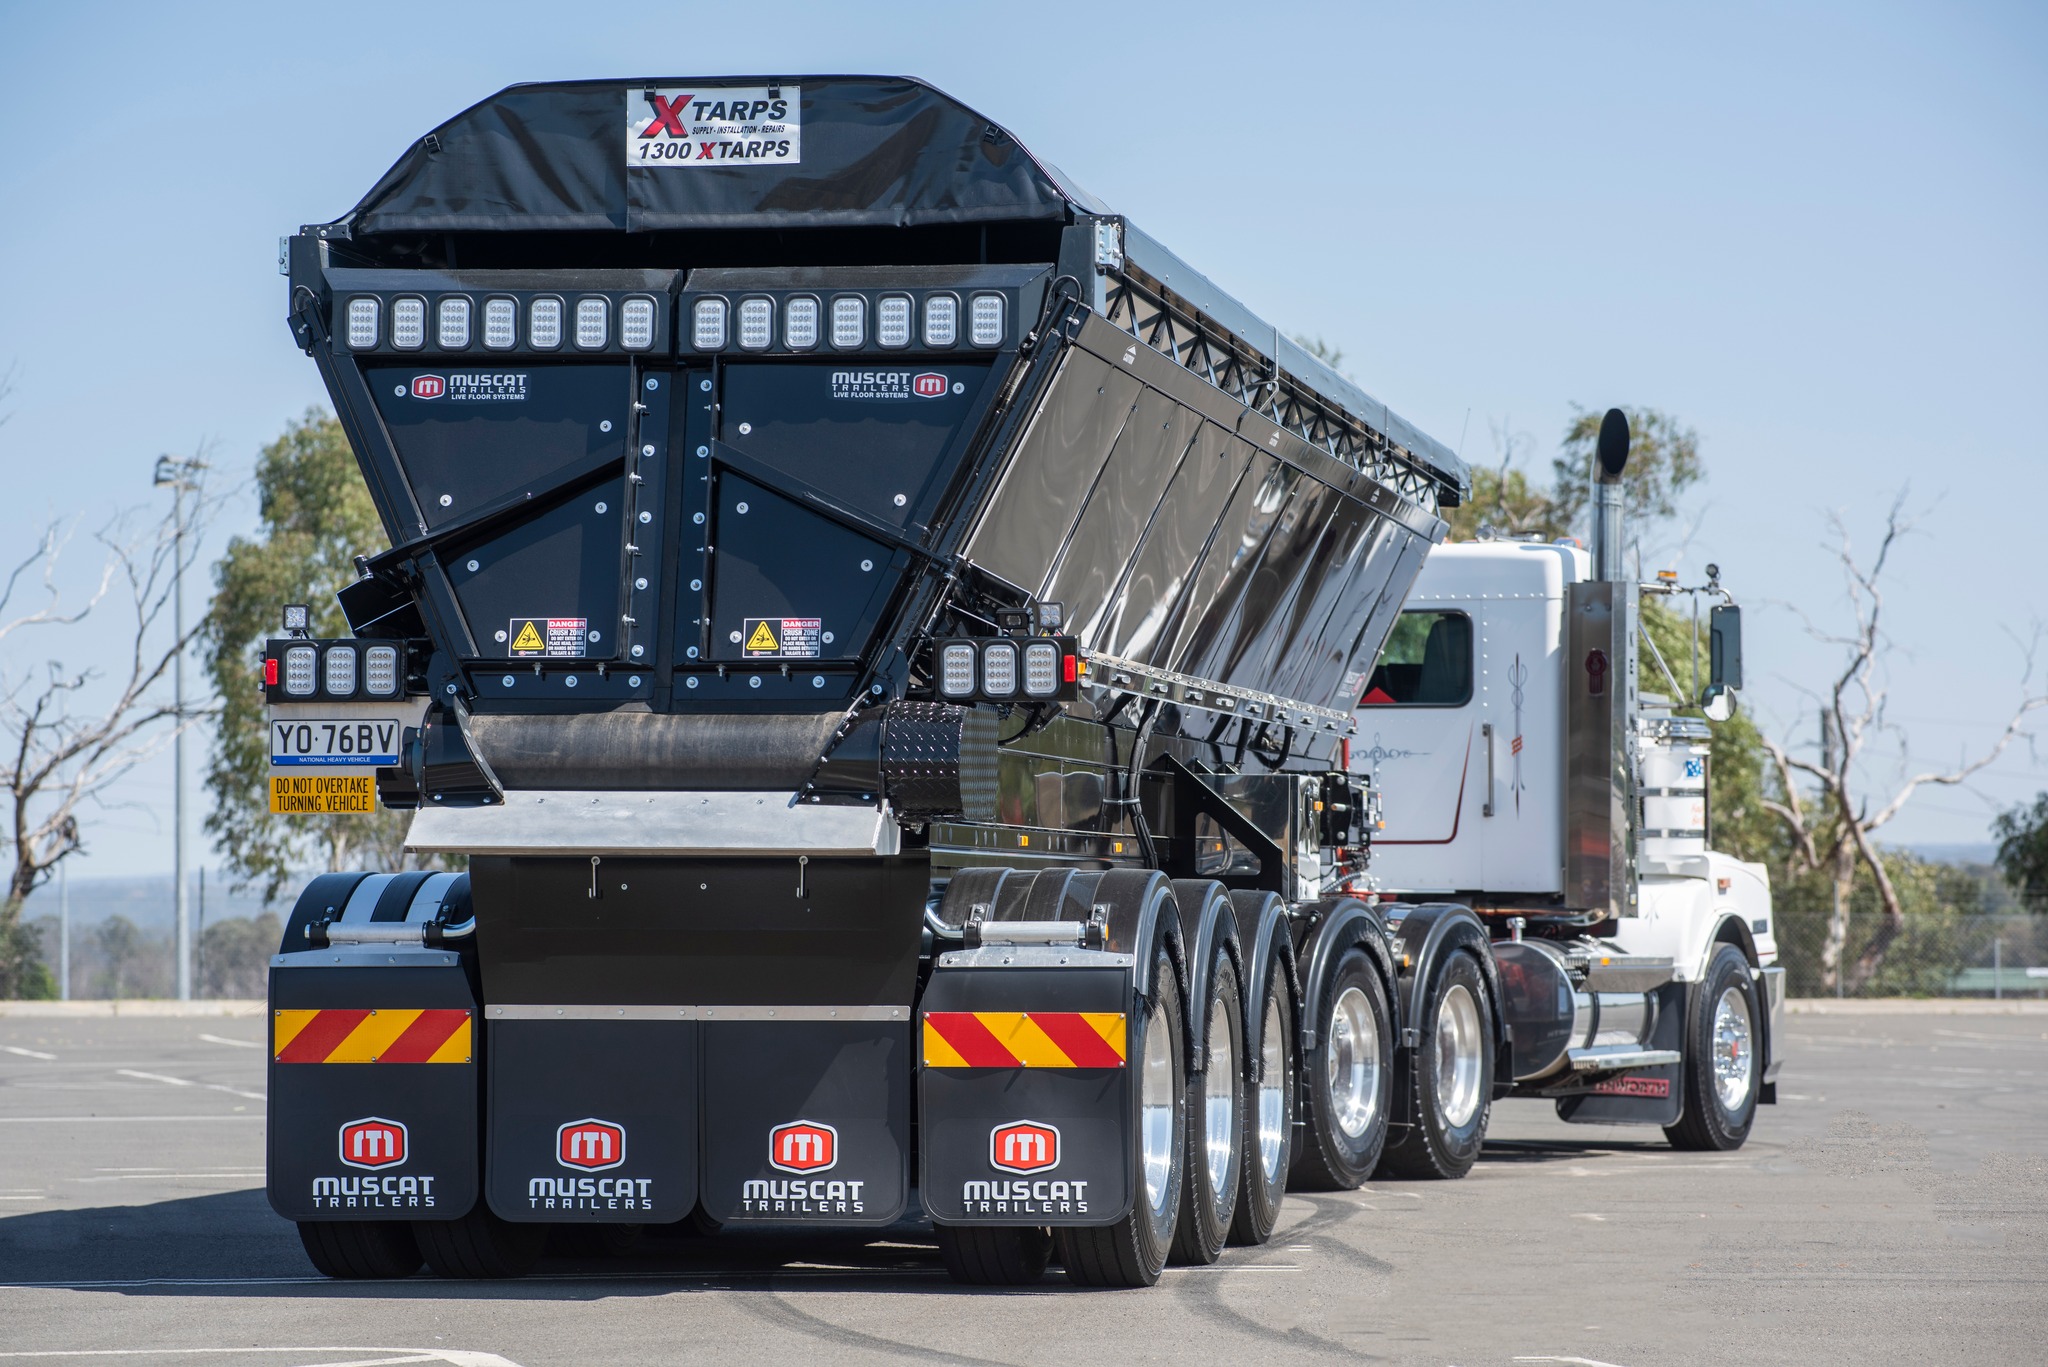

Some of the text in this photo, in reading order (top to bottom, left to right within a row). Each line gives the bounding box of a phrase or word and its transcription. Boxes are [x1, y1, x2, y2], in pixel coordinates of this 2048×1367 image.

[691, 126, 713, 135] SUPPLY
[716, 125, 757, 135] INSTALLATION
[760, 125, 786, 134] REPAIRS
[639, 142, 692, 159] 1300
[449, 374, 527, 386] MUSCAT
[832, 372, 911, 384] MUSCAT
[449, 386, 527, 394] TRAILERS
[832, 384, 910, 392] TRAILERS
[276, 778, 369, 794] DO NOT OVERTAKE
[277, 795, 369, 811] TURNING VEHICLE
[312, 1176, 435, 1196] MUSCAT
[529, 1177, 652, 1198] MUSCAT
[743, 1180, 864, 1200] MUSCAT
[963, 1180, 1088, 1200] MUSCAT
[312, 1196, 435, 1208] TRAILERS
[529, 1198, 652, 1210] TRAILERS
[743, 1200, 864, 1213] TRAILERS
[963, 1201, 1088, 1214] TRAILERS
